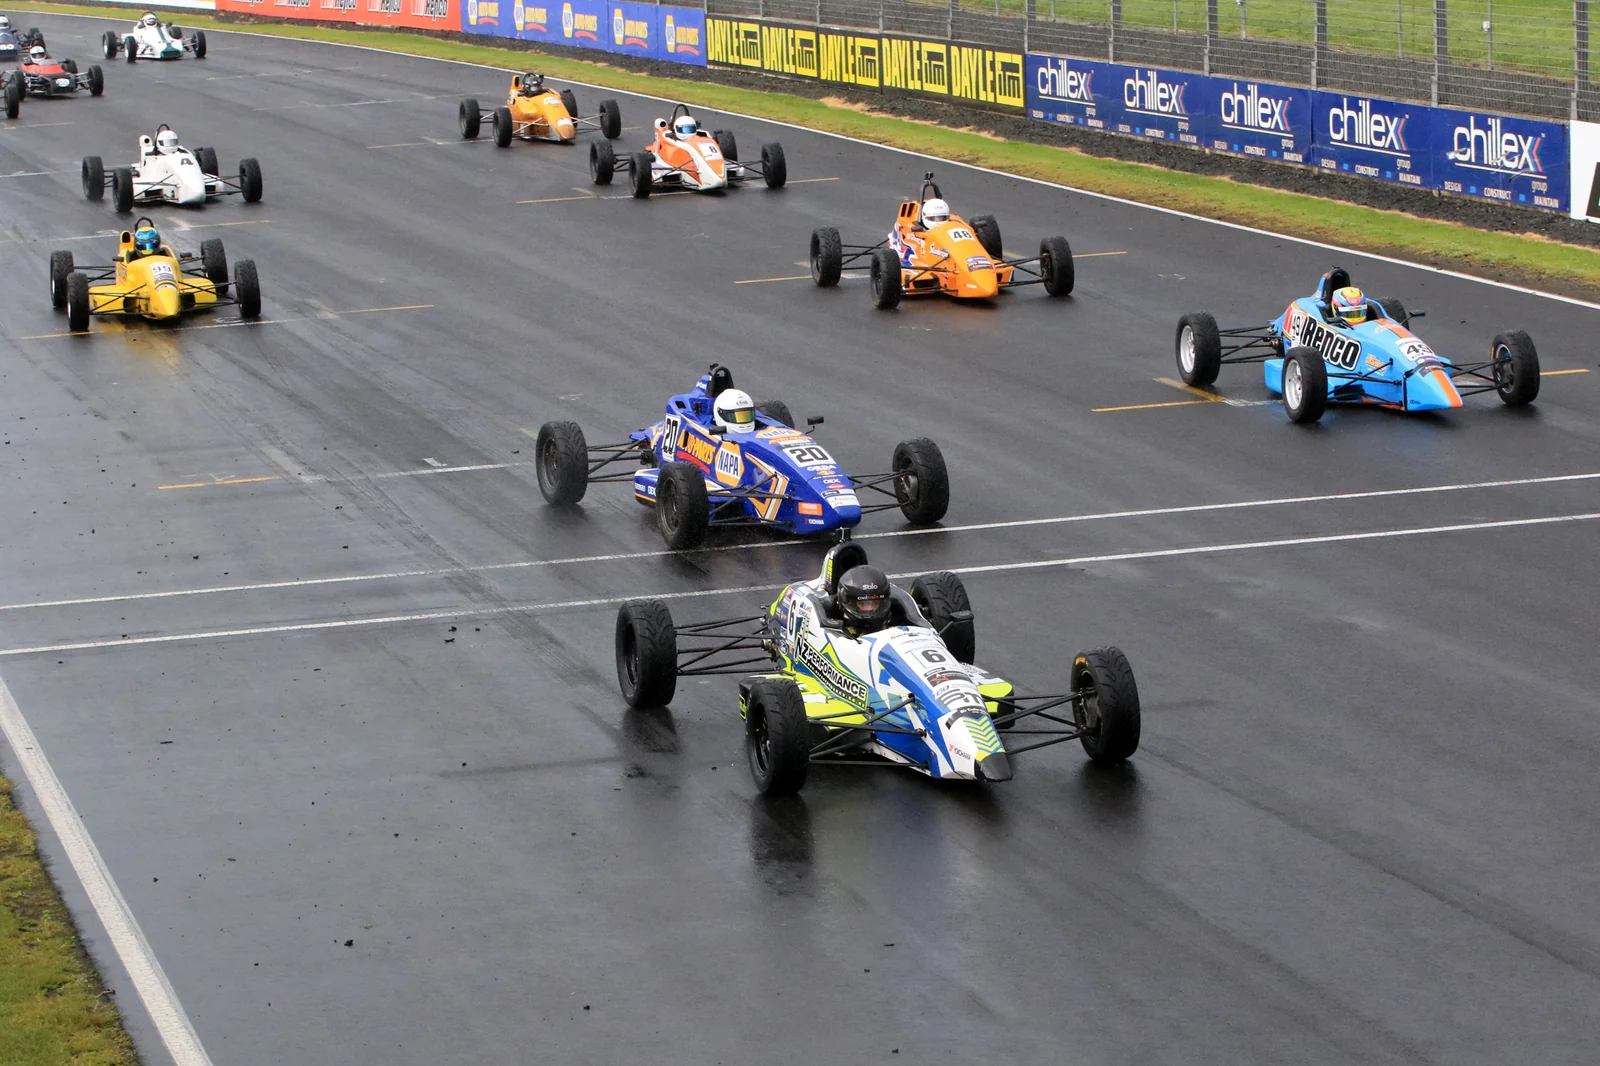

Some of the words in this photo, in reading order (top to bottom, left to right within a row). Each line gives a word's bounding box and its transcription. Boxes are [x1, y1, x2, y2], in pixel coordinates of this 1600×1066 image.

[706, 18, 740, 64] DAYLE
[762, 26, 795, 73] DAYLE
[819, 33, 855, 83] DAYLE
[882, 38, 921, 90] DAYLE
[950, 45, 995, 103] DAYLE
[1037, 58, 1093, 101] chillex
[1124, 69, 1187, 115] chillex
[1221, 83, 1291, 131] chillex
[1329, 97, 1407, 151] chillex
[1453, 115, 1543, 172] chillex
[708, 146, 718, 154] 8
[1396, 158, 1411, 171] group
[1321, 158, 1337, 170] DESIGN
[1354, 165, 1379, 177] CONSTRUCT
[1398, 172, 1421, 185] MAINTAIN
[1531, 181, 1548, 193] group
[1444, 180, 1462, 192] DESIGN
[1483, 187, 1512, 200] CONSTRUCT
[1534, 195, 1559, 209] MAINTAIN
[662, 418, 679, 455] 20
[789, 446, 830, 464] 20
[717, 450, 740, 477] NAPA
[789, 600, 797, 636] 6
[921, 649, 947, 663] 6
